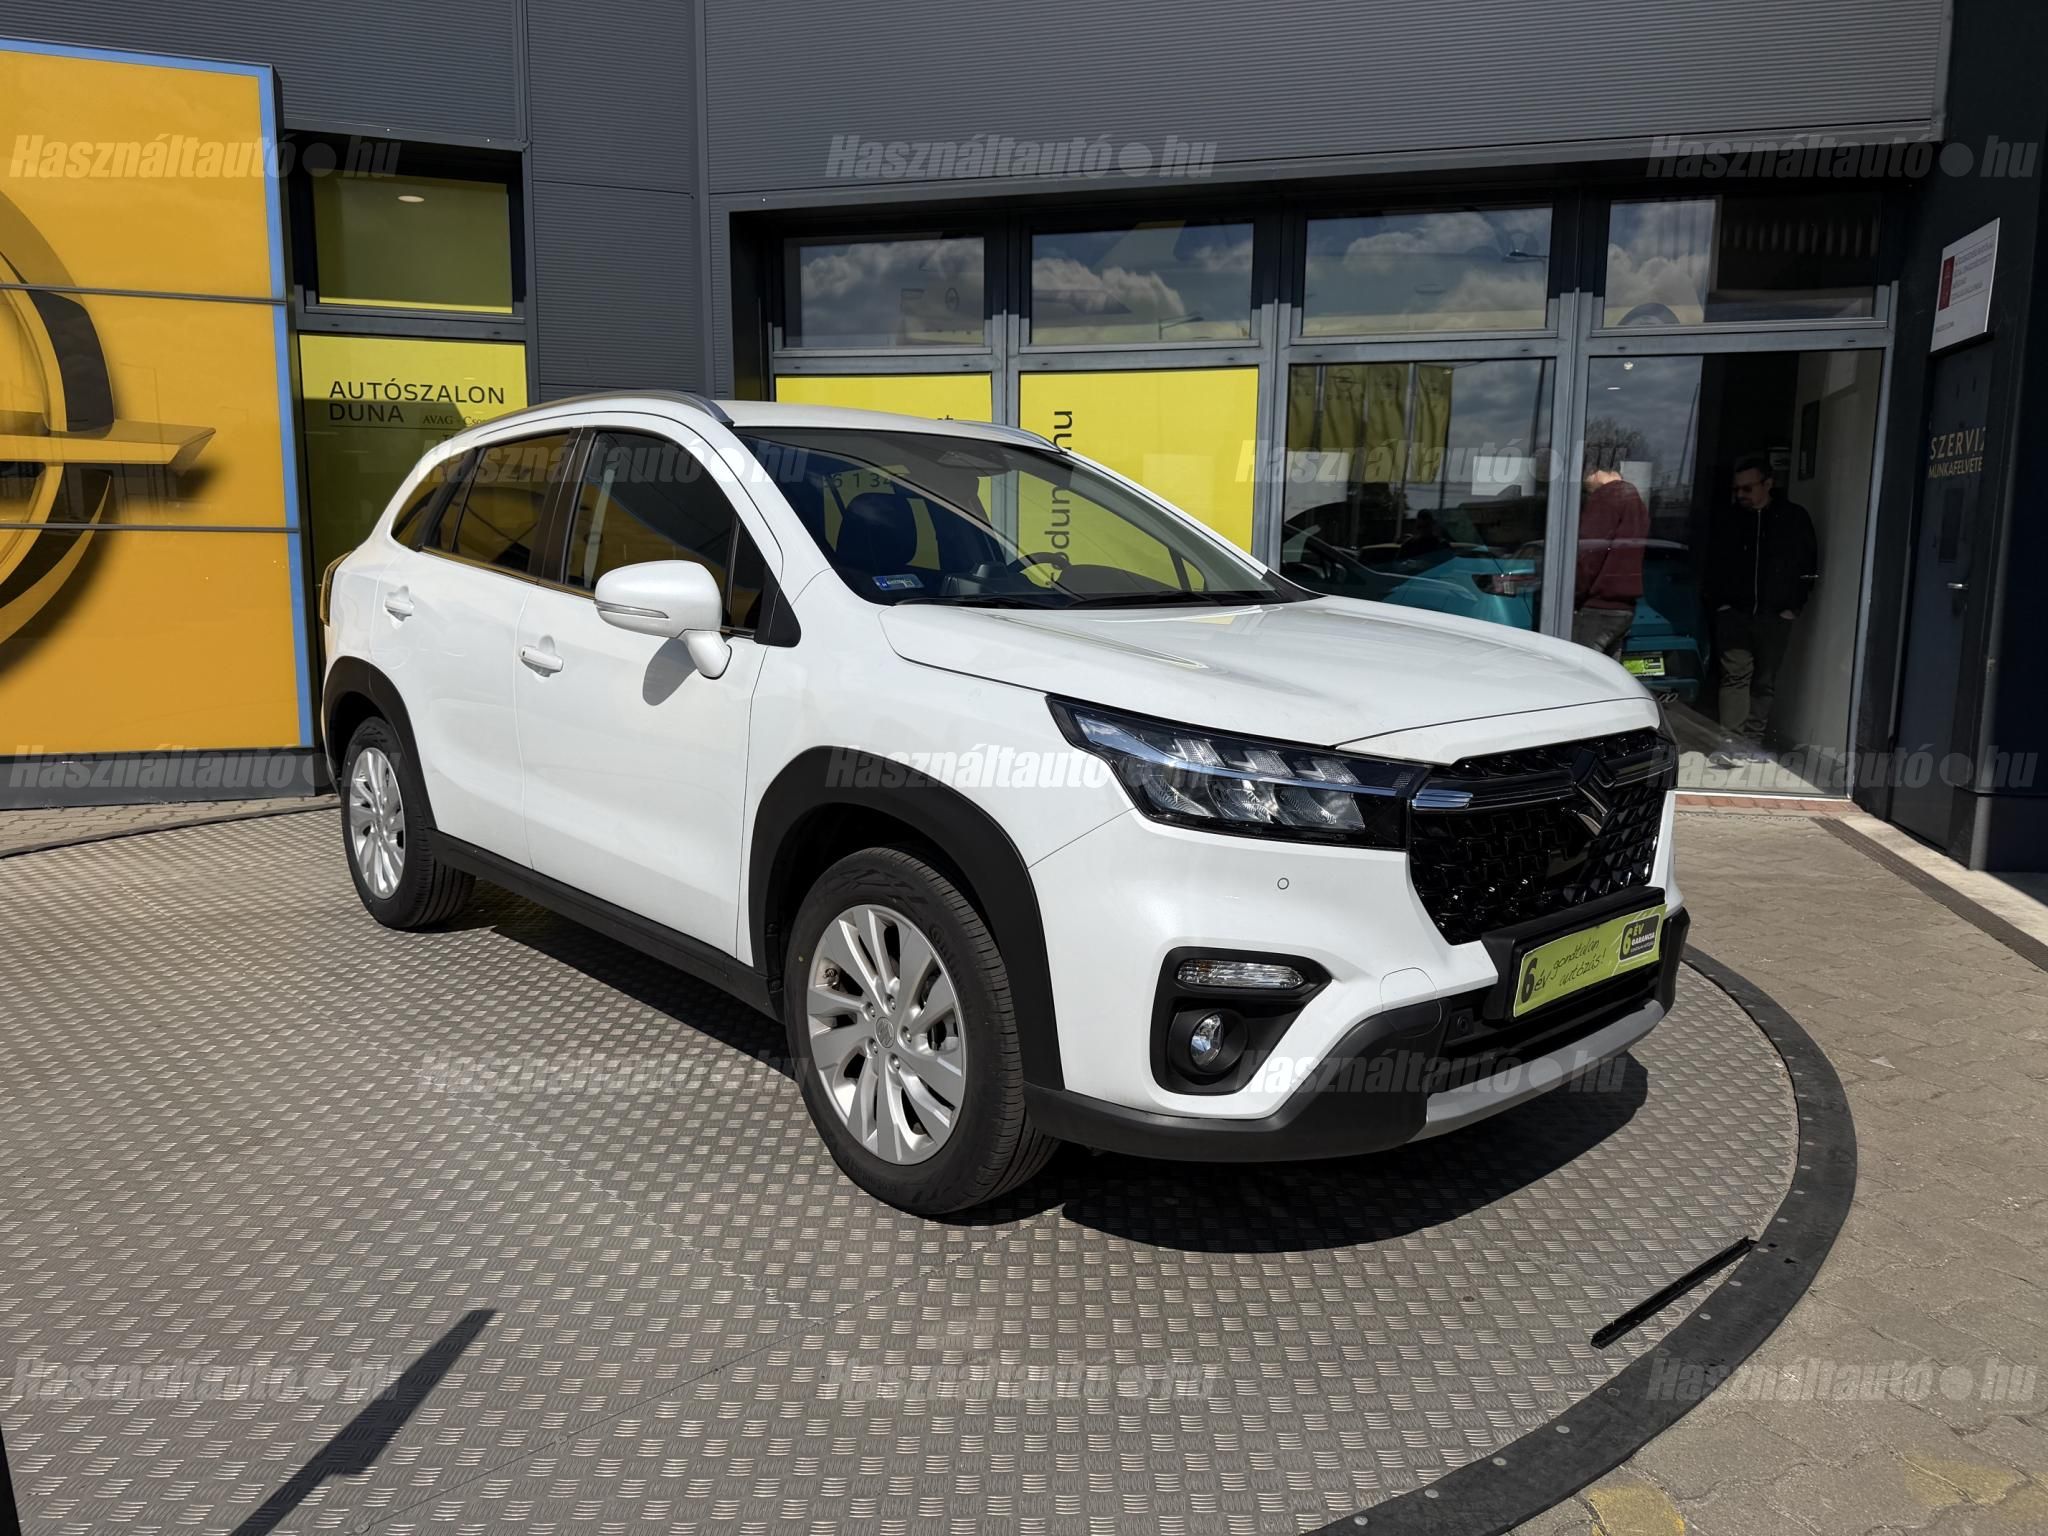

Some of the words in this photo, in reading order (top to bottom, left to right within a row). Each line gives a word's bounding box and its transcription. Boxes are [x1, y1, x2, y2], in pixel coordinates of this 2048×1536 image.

[329, 378, 504, 404] AUTÓSZALON
[329, 403, 404, 423] DUNA
[422, 415, 454, 425] AVAG
[1521, 957, 1538, 1003] 6
